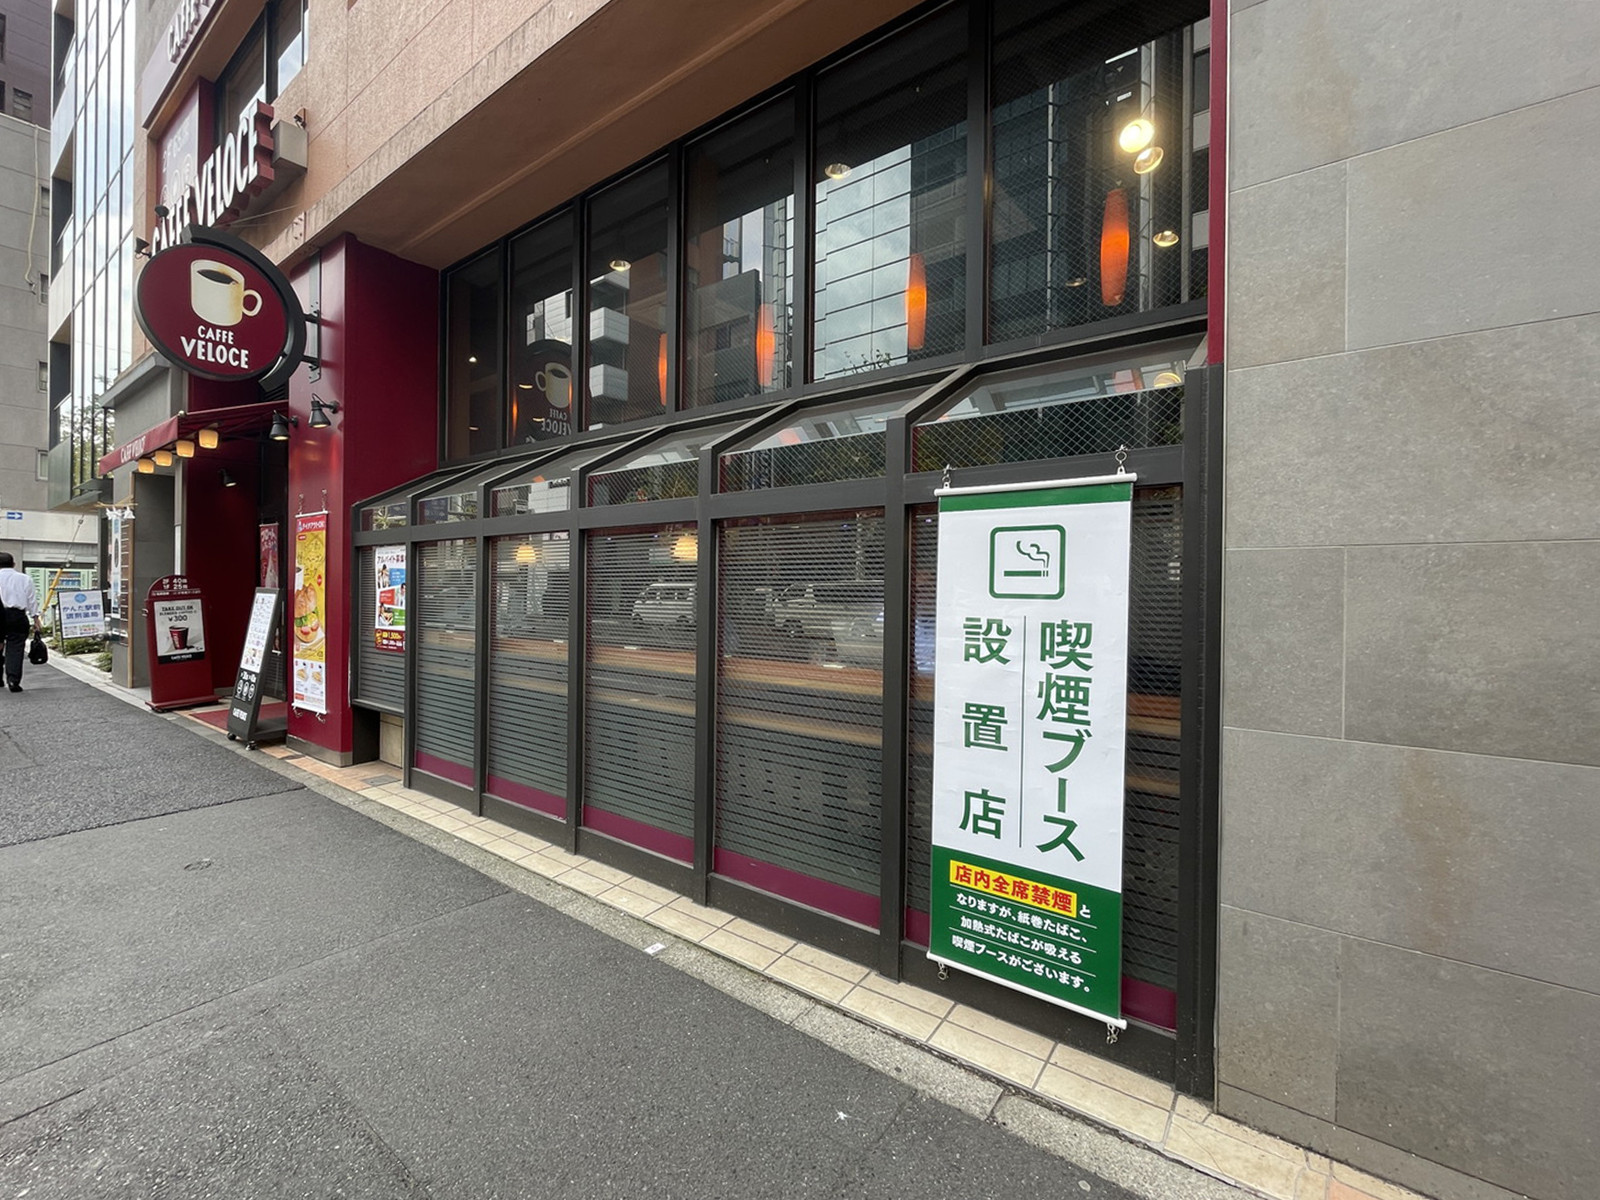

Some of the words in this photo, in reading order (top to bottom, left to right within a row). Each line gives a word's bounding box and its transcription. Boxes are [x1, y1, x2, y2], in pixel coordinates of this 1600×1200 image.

[194, 98, 259, 228] VELOCE
[180, 335, 249, 369] VELOCE
[197, 325, 234, 345] CAFFE
[958, 616, 1012, 840] 設置店
[1035, 619, 1094, 862] 喫煙ブース
[954, 864, 1073, 914] 店内全席禁煙
[951, 934, 1091, 993] 喫煙ブースがございます。
[960, 915, 1082, 965] 加熱式たばこが吸える
